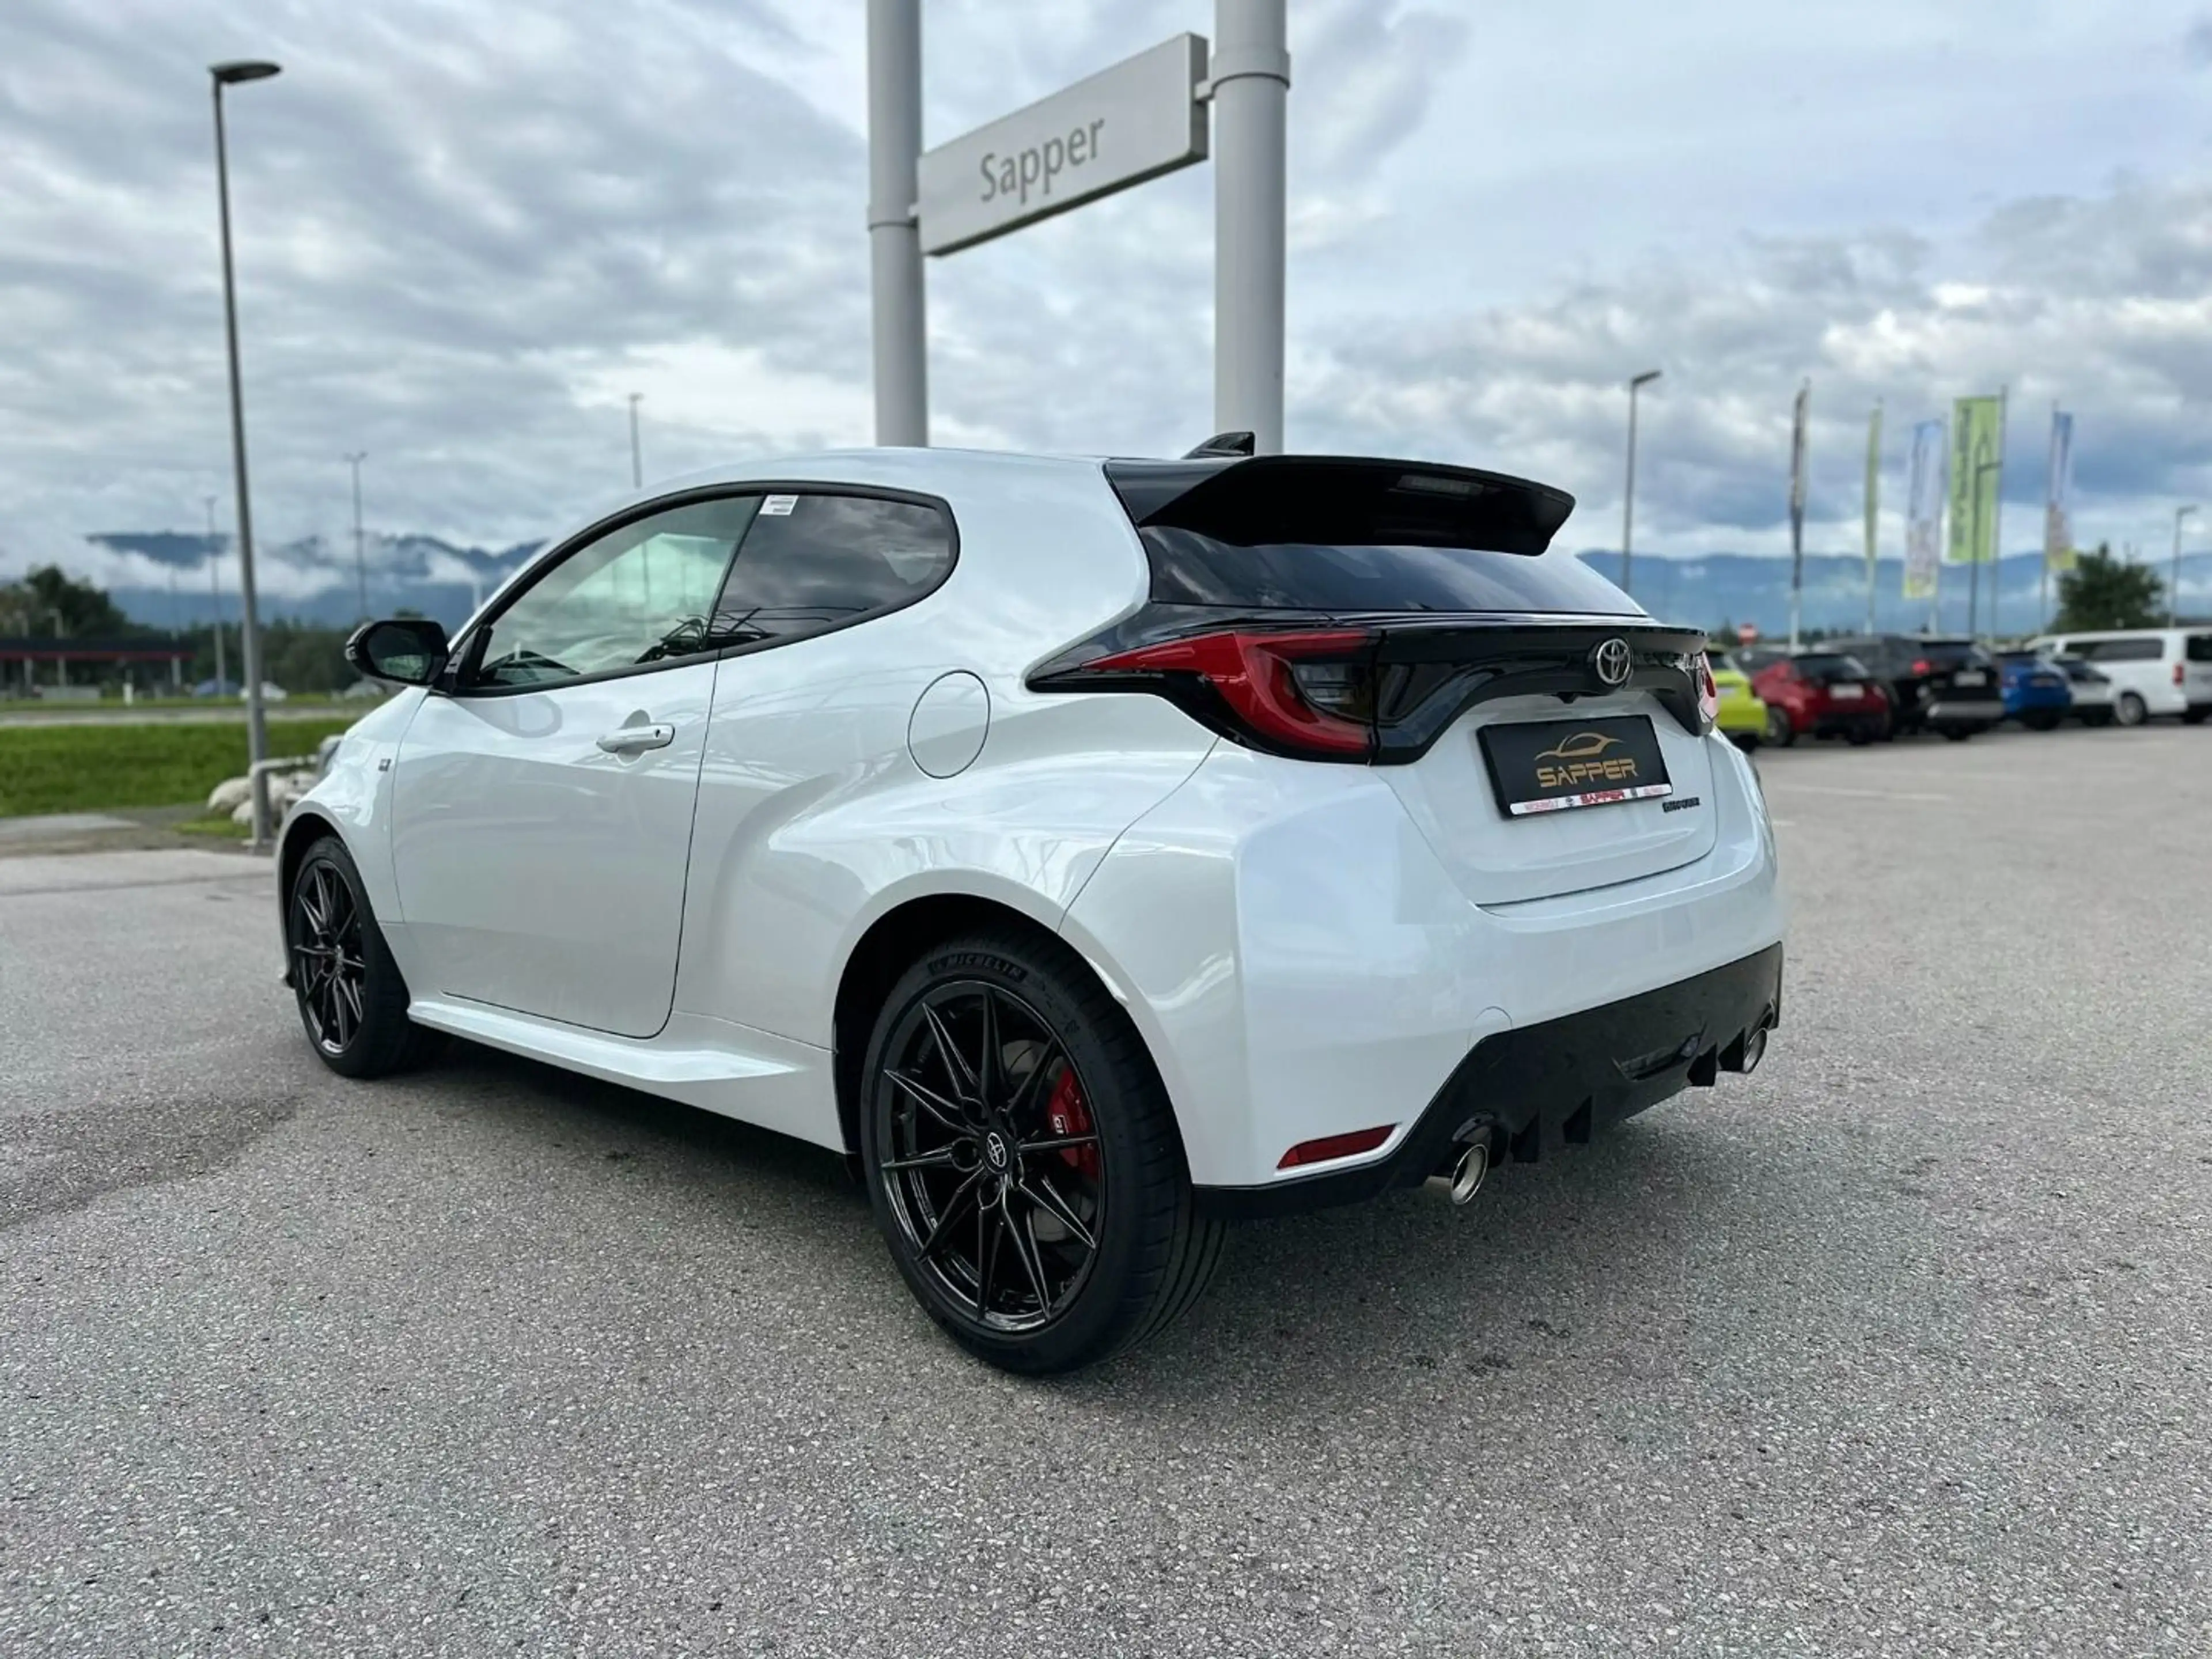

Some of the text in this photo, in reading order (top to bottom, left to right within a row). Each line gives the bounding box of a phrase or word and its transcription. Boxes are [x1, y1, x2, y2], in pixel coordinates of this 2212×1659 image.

[980, 118, 1105, 206] Sapper
[1536, 758, 1639, 788] SAPPER
[945, 954, 1022, 976] MICHELIN
